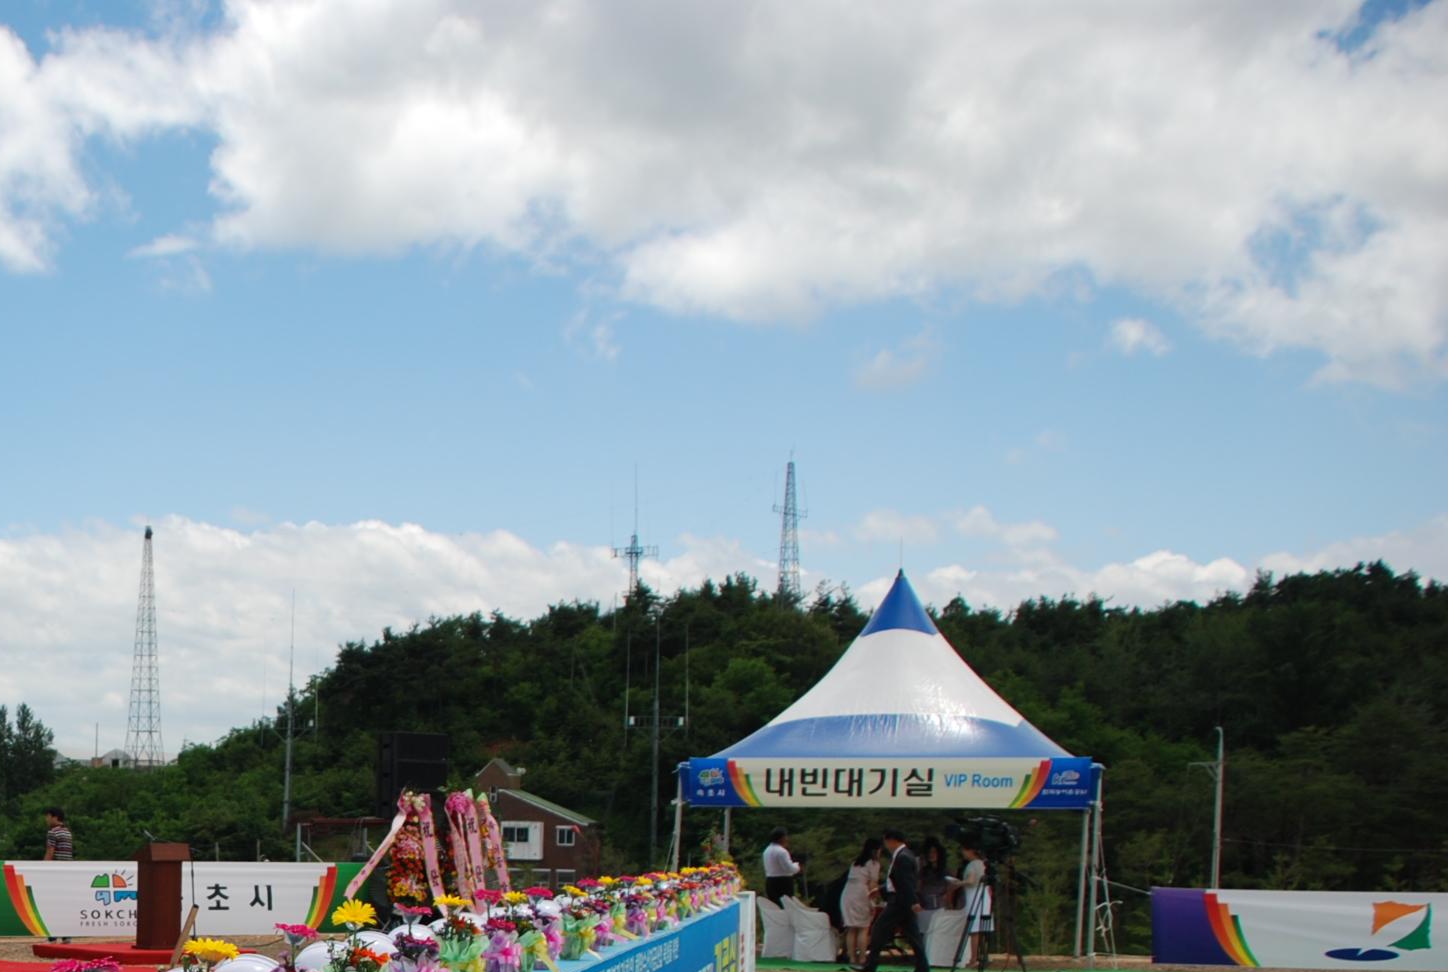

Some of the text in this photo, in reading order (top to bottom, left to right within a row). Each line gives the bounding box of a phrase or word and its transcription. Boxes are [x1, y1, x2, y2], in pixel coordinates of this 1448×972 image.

[764, 767, 1014, 798] 내빈대기실 VIP Room
[79, 909, 138, 920] SOKCH
[113, 920, 138, 928] SOKC
